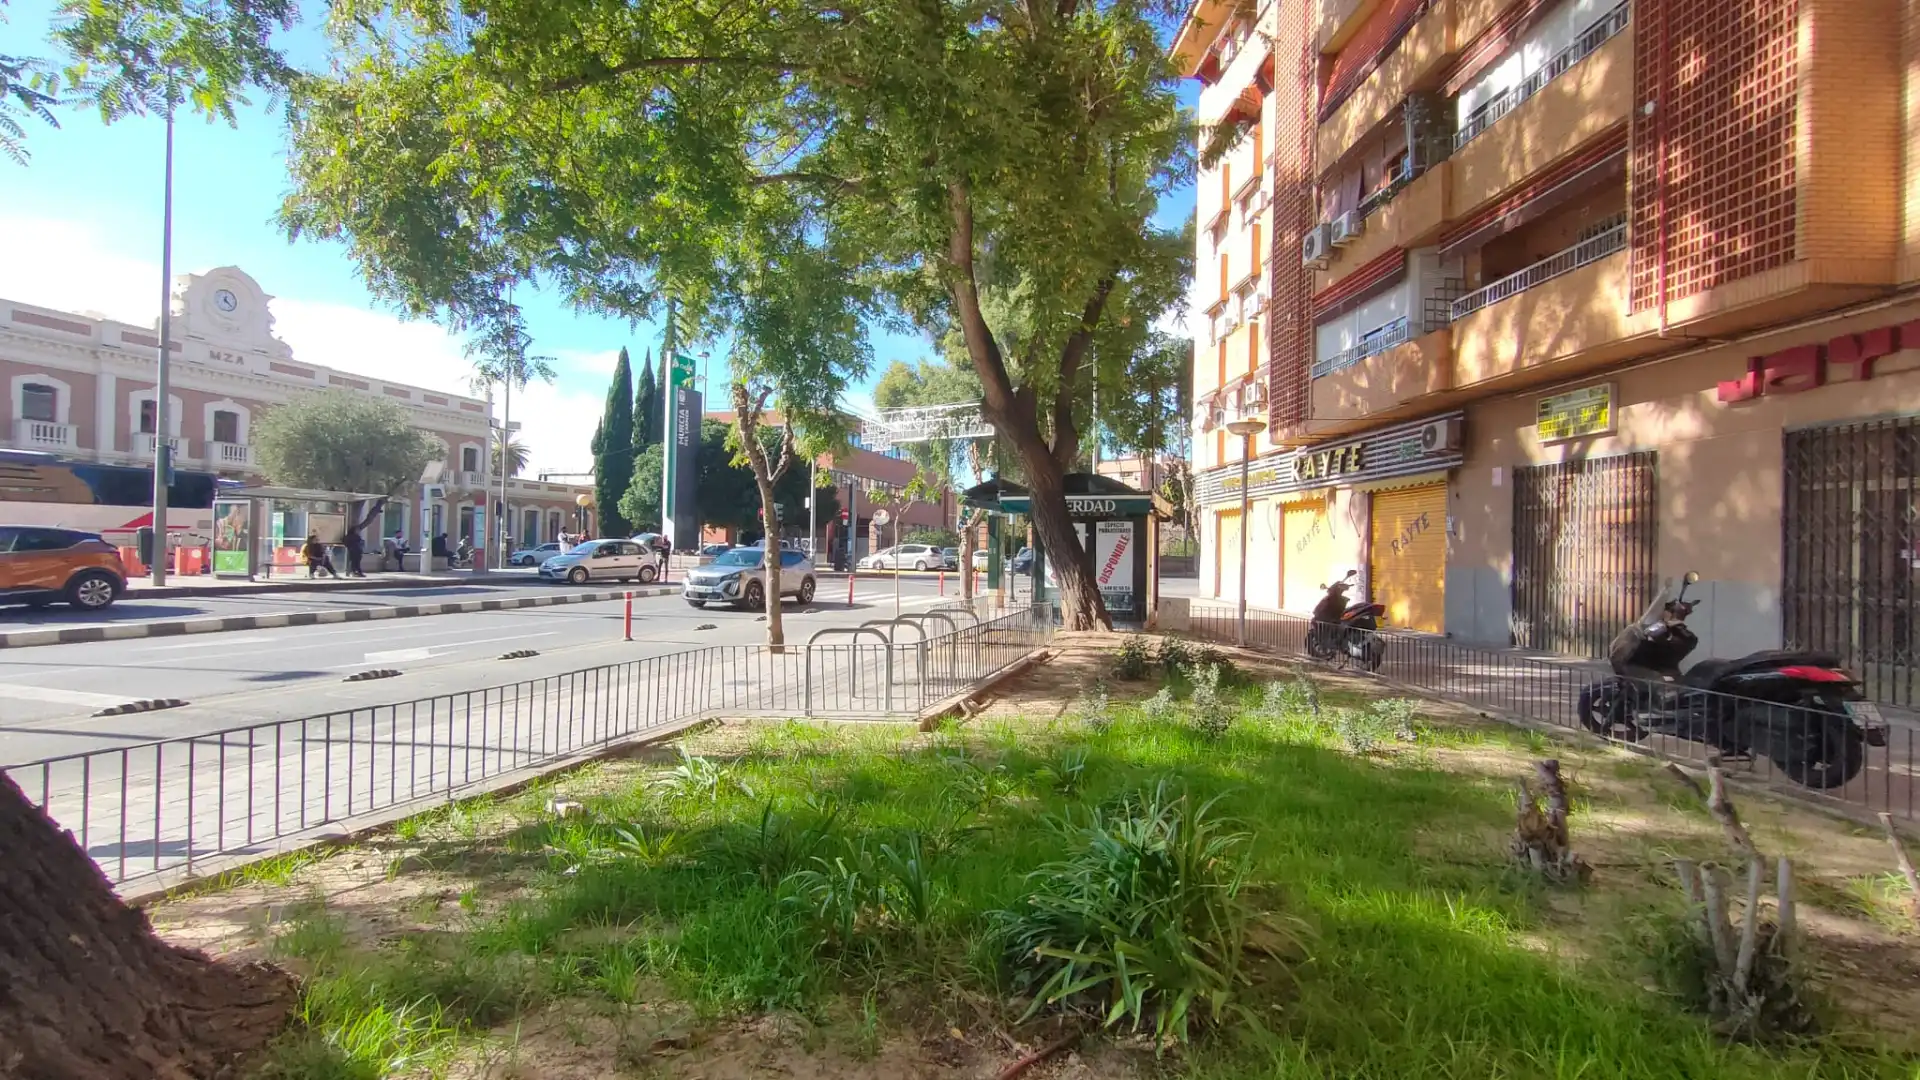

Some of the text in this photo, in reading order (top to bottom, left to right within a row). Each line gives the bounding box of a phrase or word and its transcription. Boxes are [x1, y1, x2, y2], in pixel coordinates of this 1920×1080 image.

[209, 350, 244, 365] MZA
[1290, 442, 1362, 481] RAYTE
[1065, 499, 1116, 513] ERDAD
[1391, 511, 1430, 555] RAYTE
[1098, 533, 1130, 585] DISPONIBLE
